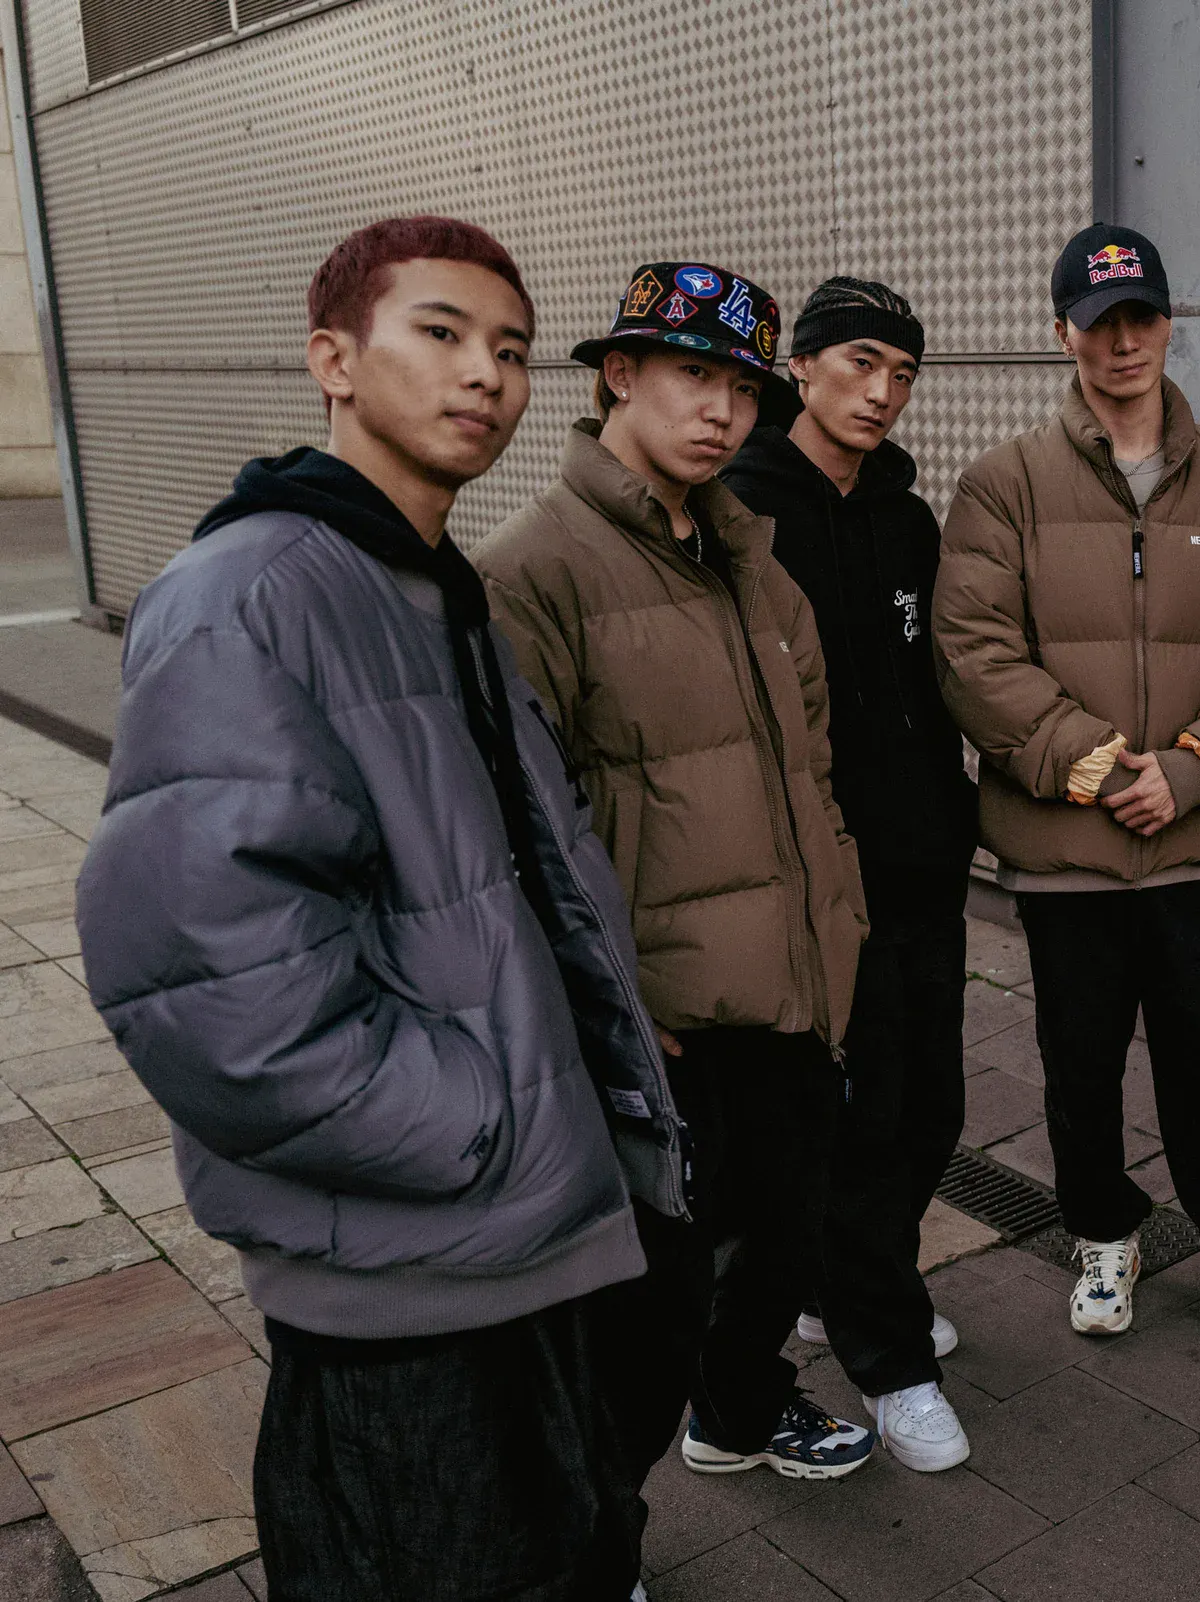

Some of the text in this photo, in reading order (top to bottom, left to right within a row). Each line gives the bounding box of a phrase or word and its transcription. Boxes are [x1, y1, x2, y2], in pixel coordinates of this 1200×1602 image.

[1089, 263, 1144, 285] Red Bull
[718, 278, 758, 340] LA
